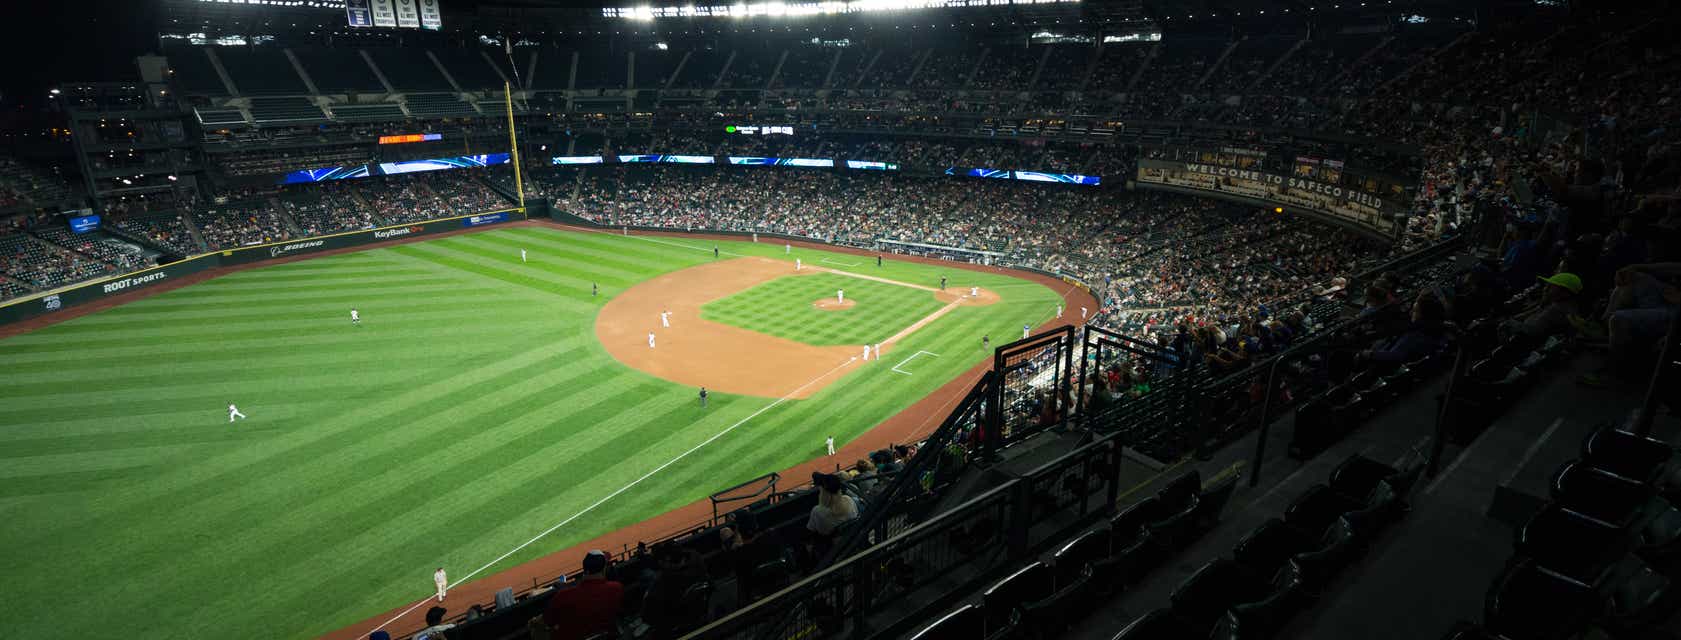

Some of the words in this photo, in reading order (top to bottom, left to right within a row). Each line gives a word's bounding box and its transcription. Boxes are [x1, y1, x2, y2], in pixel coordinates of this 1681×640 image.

[1186, 163, 1260, 181] WELCOME
[1266, 174, 1283, 184] TO
[1289, 178, 1343, 197] SAFECO
[1348, 191, 1382, 209] FIELD
[374, 226, 411, 239] KeyBank
[284, 240, 323, 251] BOEING
[104, 278, 131, 294] ROOT
